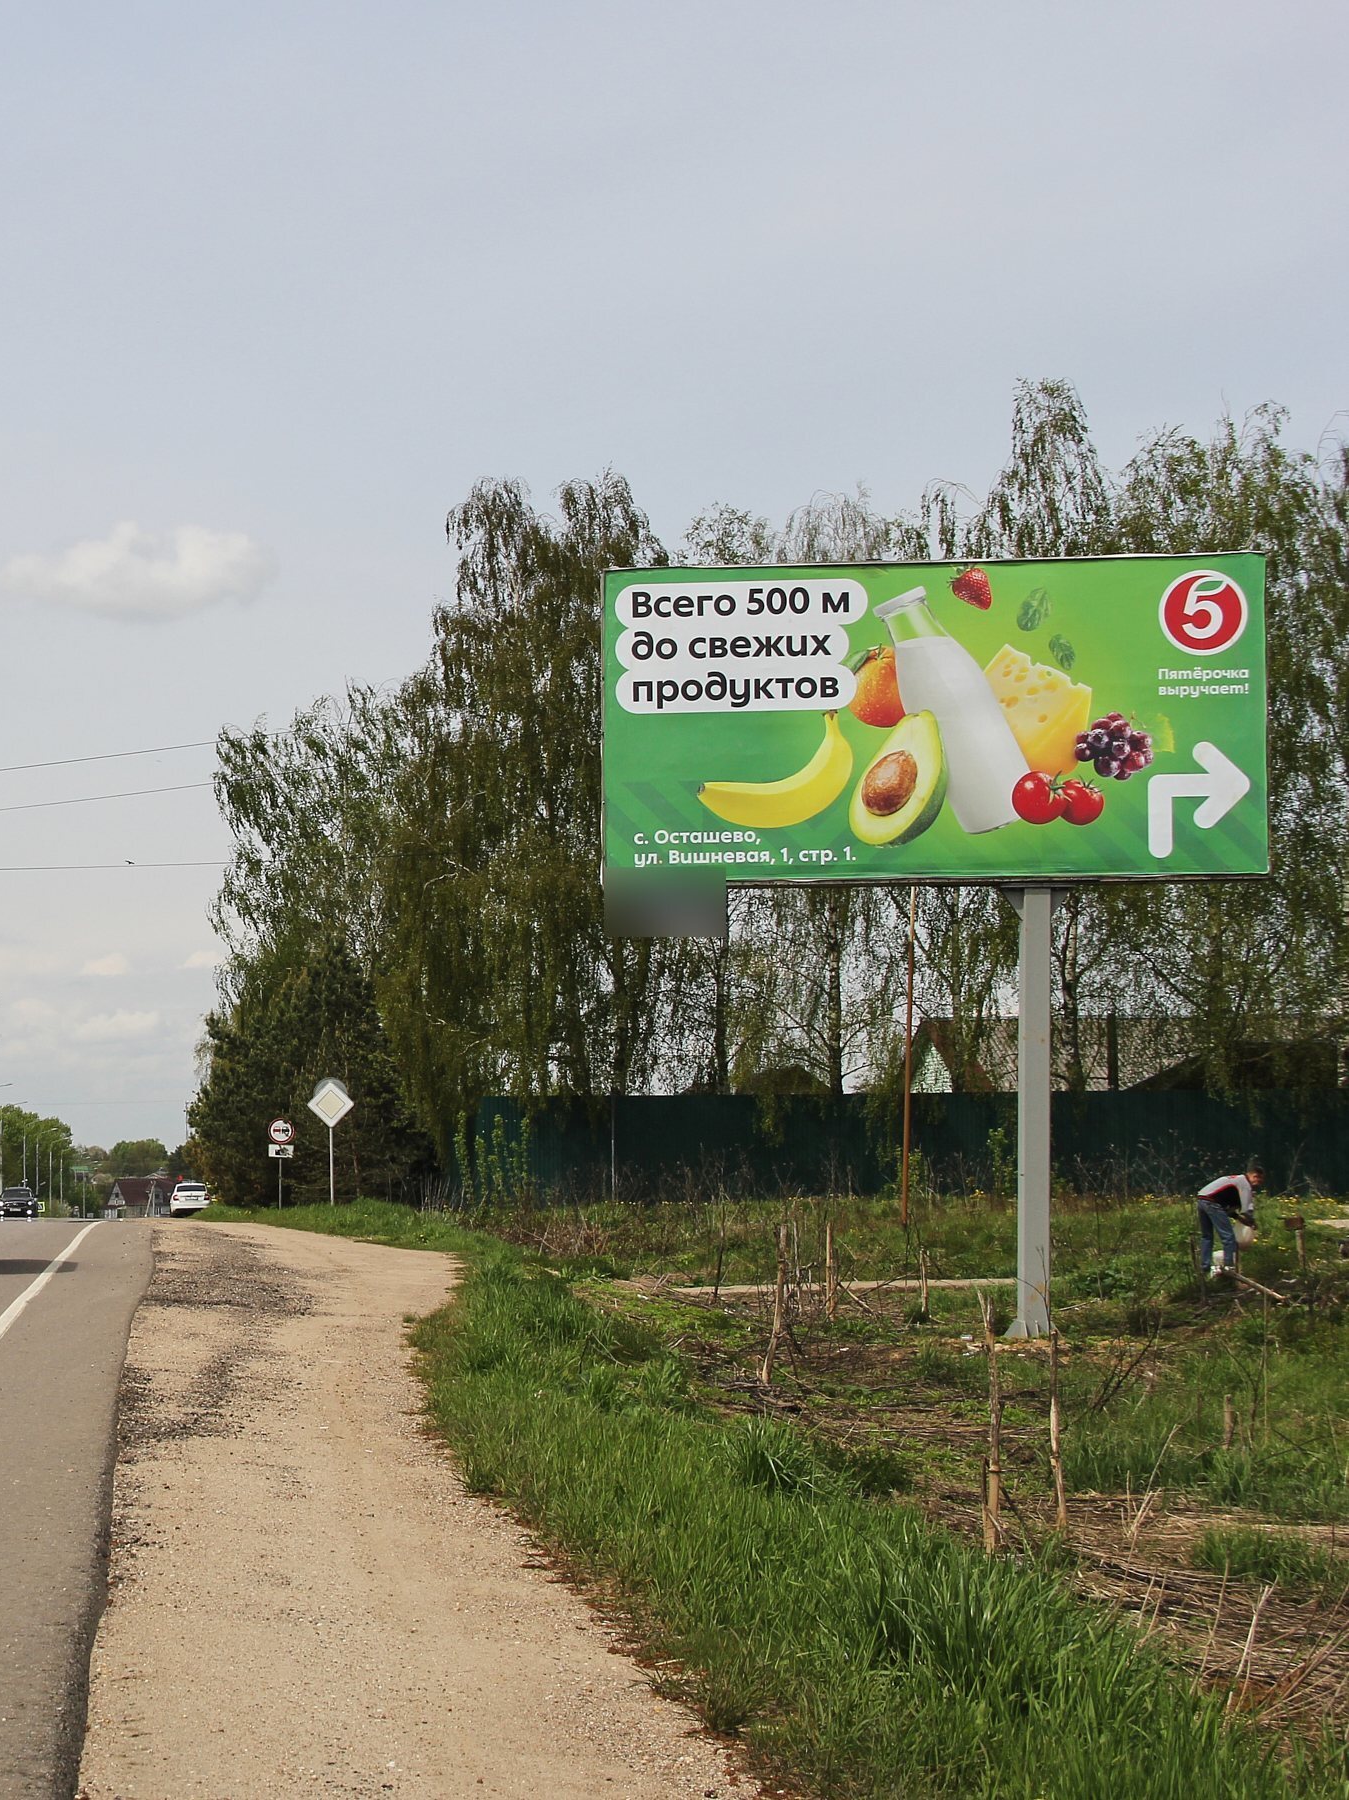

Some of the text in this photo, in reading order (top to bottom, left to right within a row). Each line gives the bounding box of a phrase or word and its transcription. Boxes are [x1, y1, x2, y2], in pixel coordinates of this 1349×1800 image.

[631, 587, 850, 618] Всего 500 м
[1181, 577, 1227, 640] 5
[631, 631, 831, 660] до свежих
[1158, 667, 1249, 681] Пятёрочка
[632, 671, 840, 709] продуктов
[1158, 683, 1249, 698] выручает!
[633, 829, 761, 845] с. Осташево,
[634, 846, 856, 868] ул. Вишневая, 1, стр. 1.
